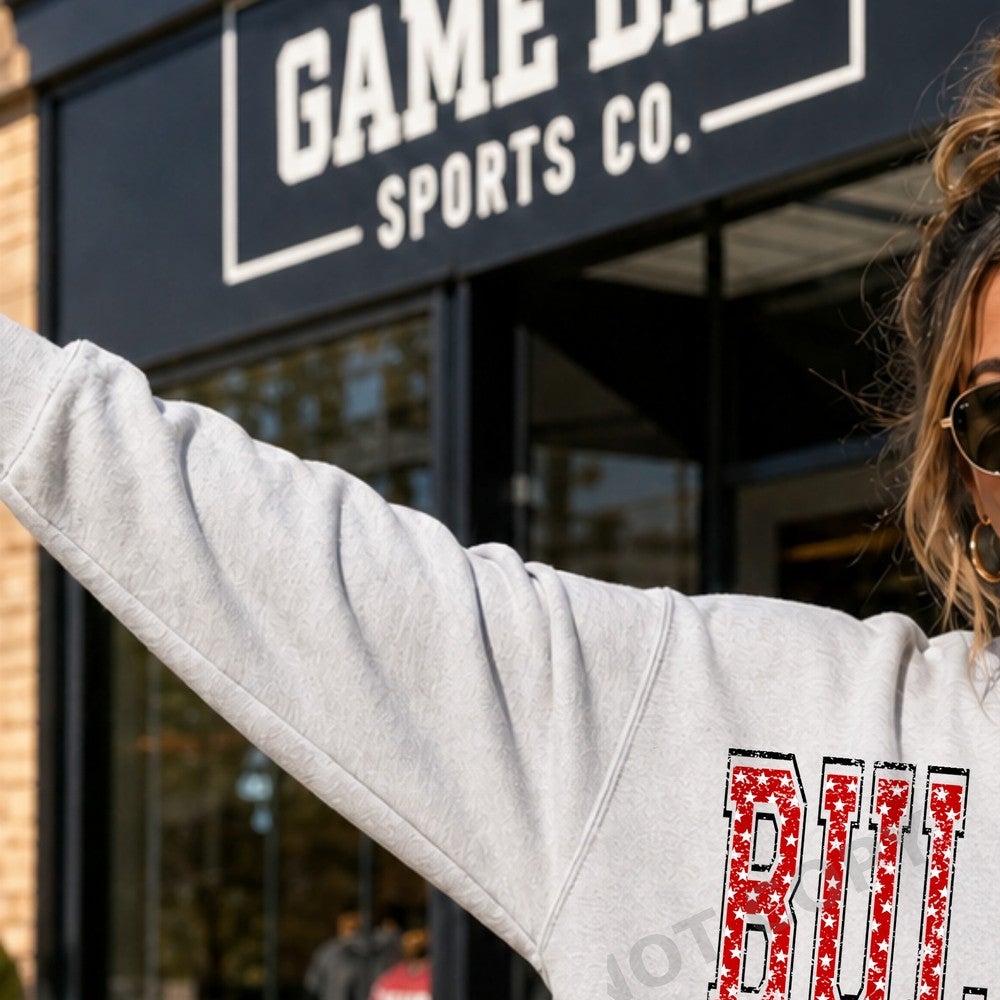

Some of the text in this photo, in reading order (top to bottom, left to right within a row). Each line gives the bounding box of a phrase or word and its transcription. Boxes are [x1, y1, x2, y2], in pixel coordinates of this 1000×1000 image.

[276, 0, 558, 186] GAME
[375, 81, 691, 250] SPORTS CO.
